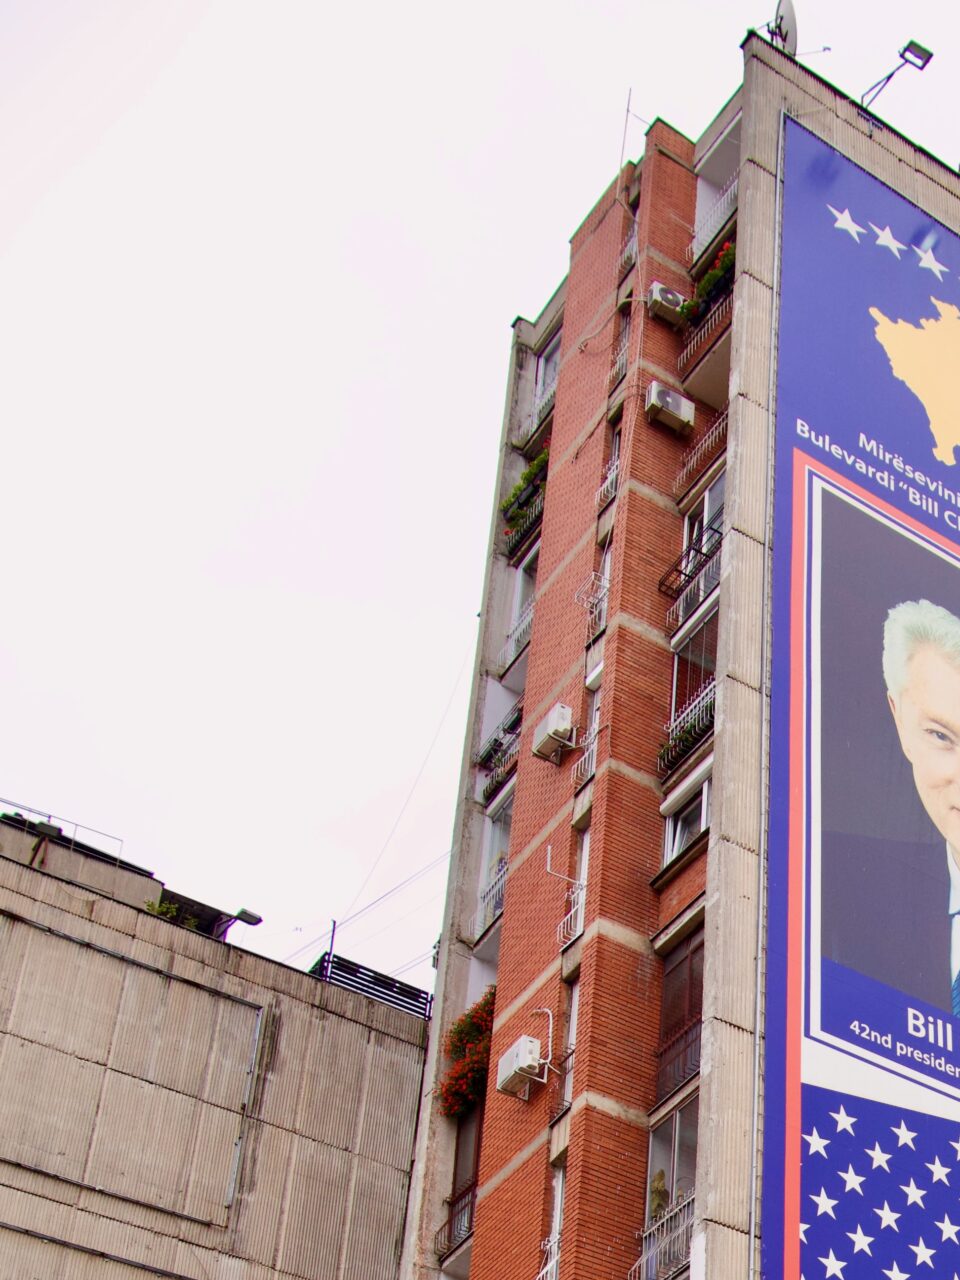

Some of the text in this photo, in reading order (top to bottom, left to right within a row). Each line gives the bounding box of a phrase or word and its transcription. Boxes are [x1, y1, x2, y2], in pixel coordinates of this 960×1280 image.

[796, 418, 895, 492] Bulevardi
[849, 1020, 892, 1049] 42nd
[907, 1007, 953, 1052] Bill
